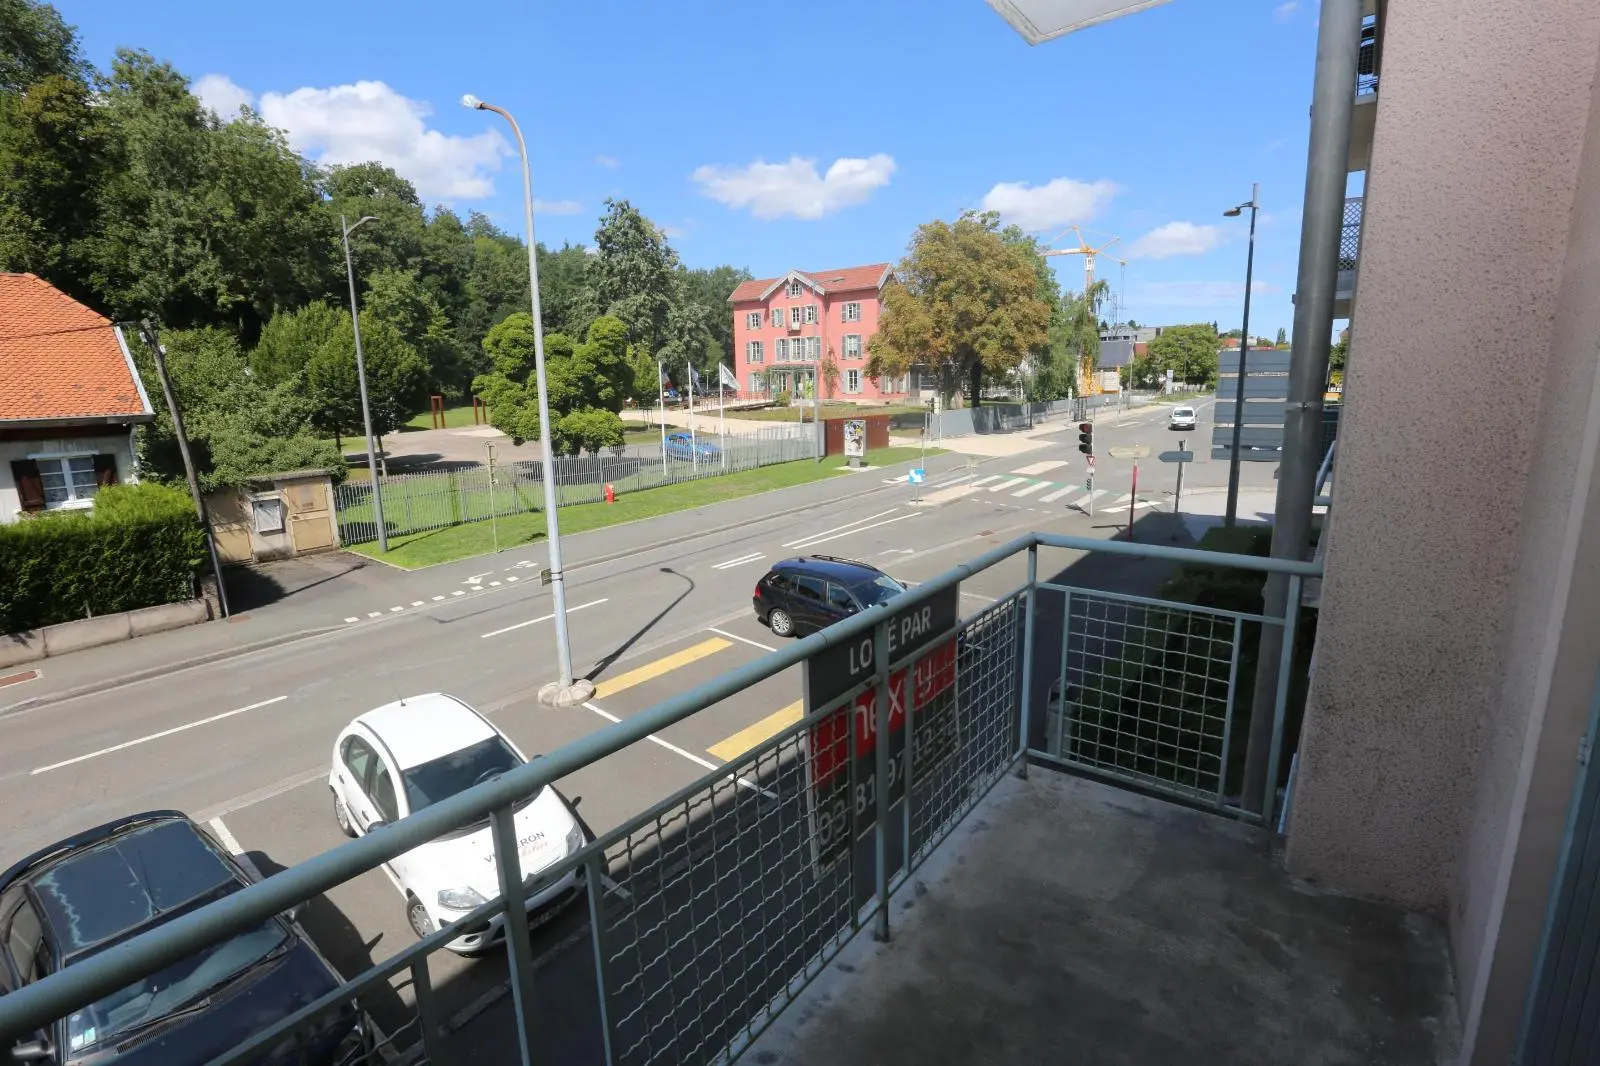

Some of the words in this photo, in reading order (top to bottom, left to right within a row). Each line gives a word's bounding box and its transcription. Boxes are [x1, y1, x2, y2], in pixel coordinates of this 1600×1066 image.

[849, 616, 897, 676] LOÉ
[901, 605, 932, 646] PAR
[855, 658, 933, 741] nexy
[855, 773, 876, 817] 81
